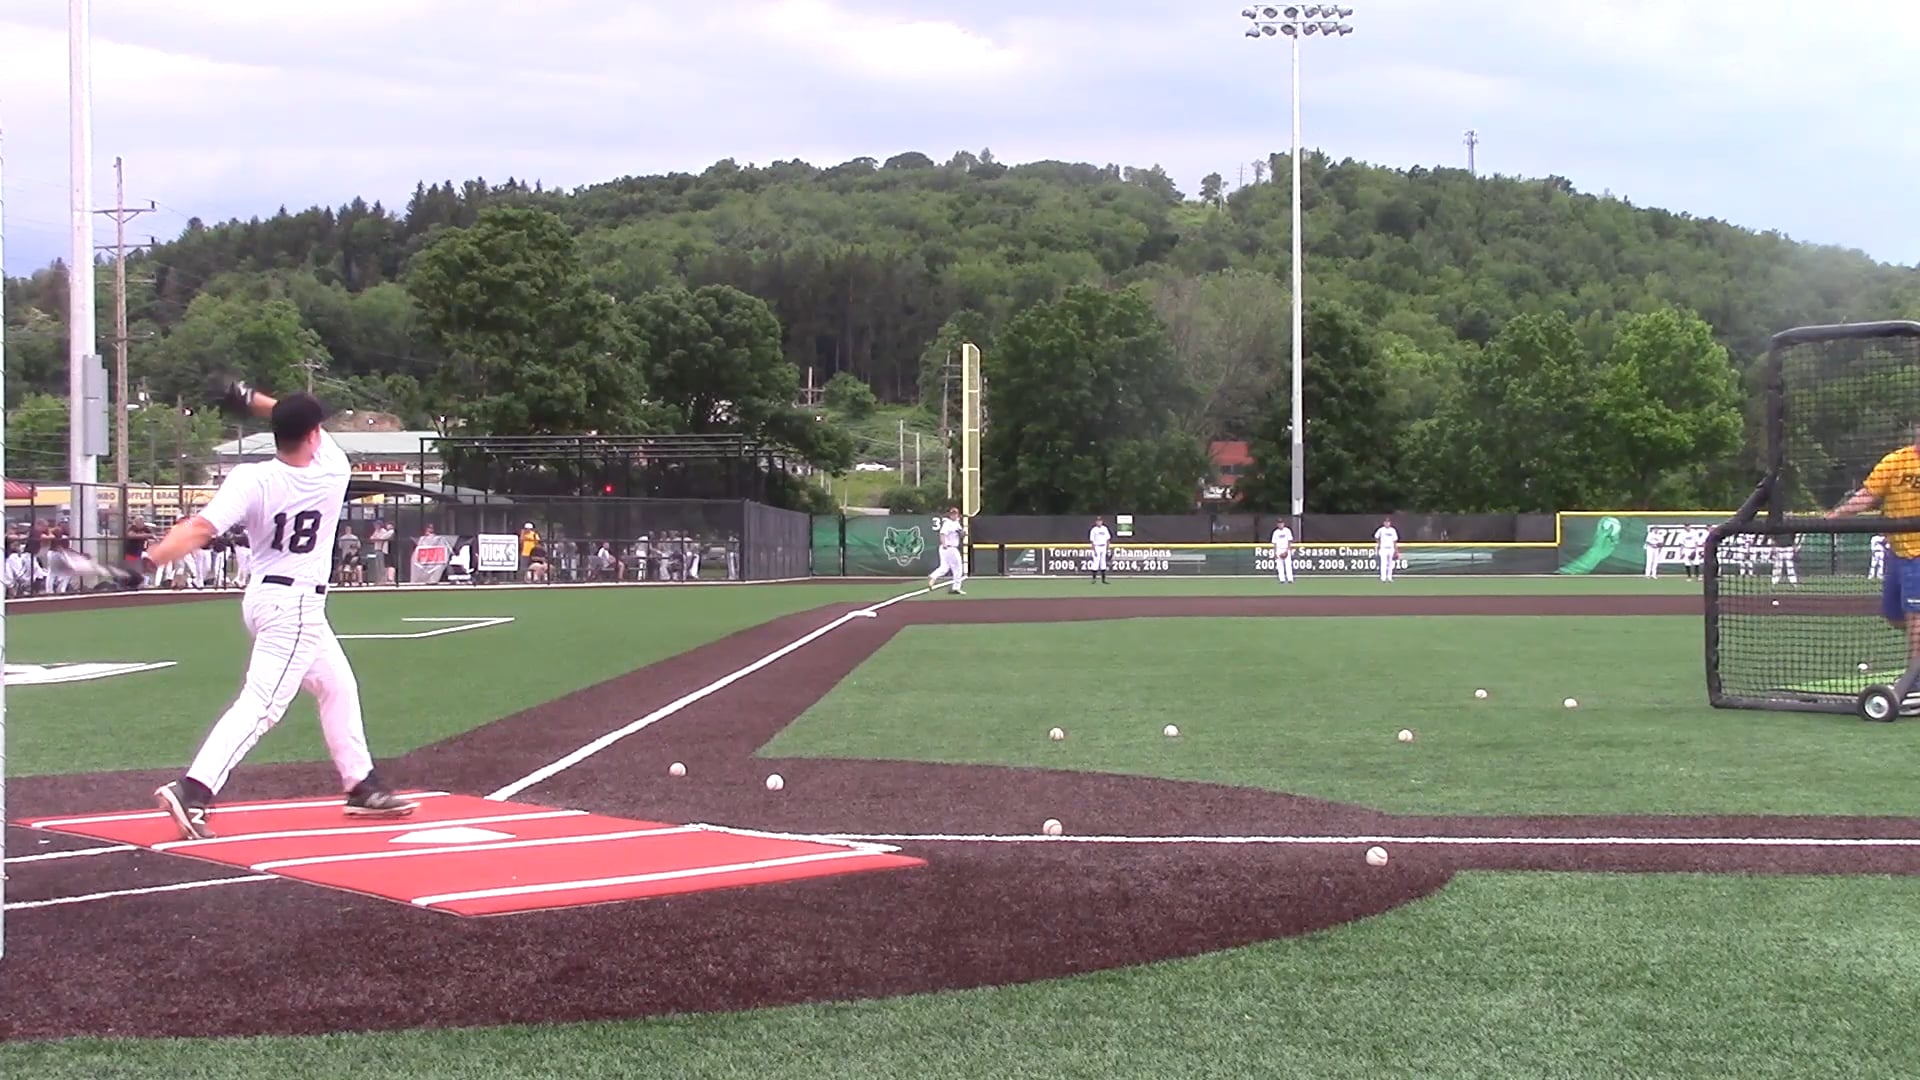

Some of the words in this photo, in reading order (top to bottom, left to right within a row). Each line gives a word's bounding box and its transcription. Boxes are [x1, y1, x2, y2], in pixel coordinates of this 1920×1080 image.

[271, 510, 323, 554] 18
[1049, 547, 1111, 557] Tournam
[1113, 547, 1171, 559] Champions
[1255, 547, 1296, 558] Regr
[1299, 547, 1337, 557] Season
[1339, 547, 1379, 559] Champi
[1081, 560, 1110, 572] 20,
[1292, 559, 1316, 571] 008,
